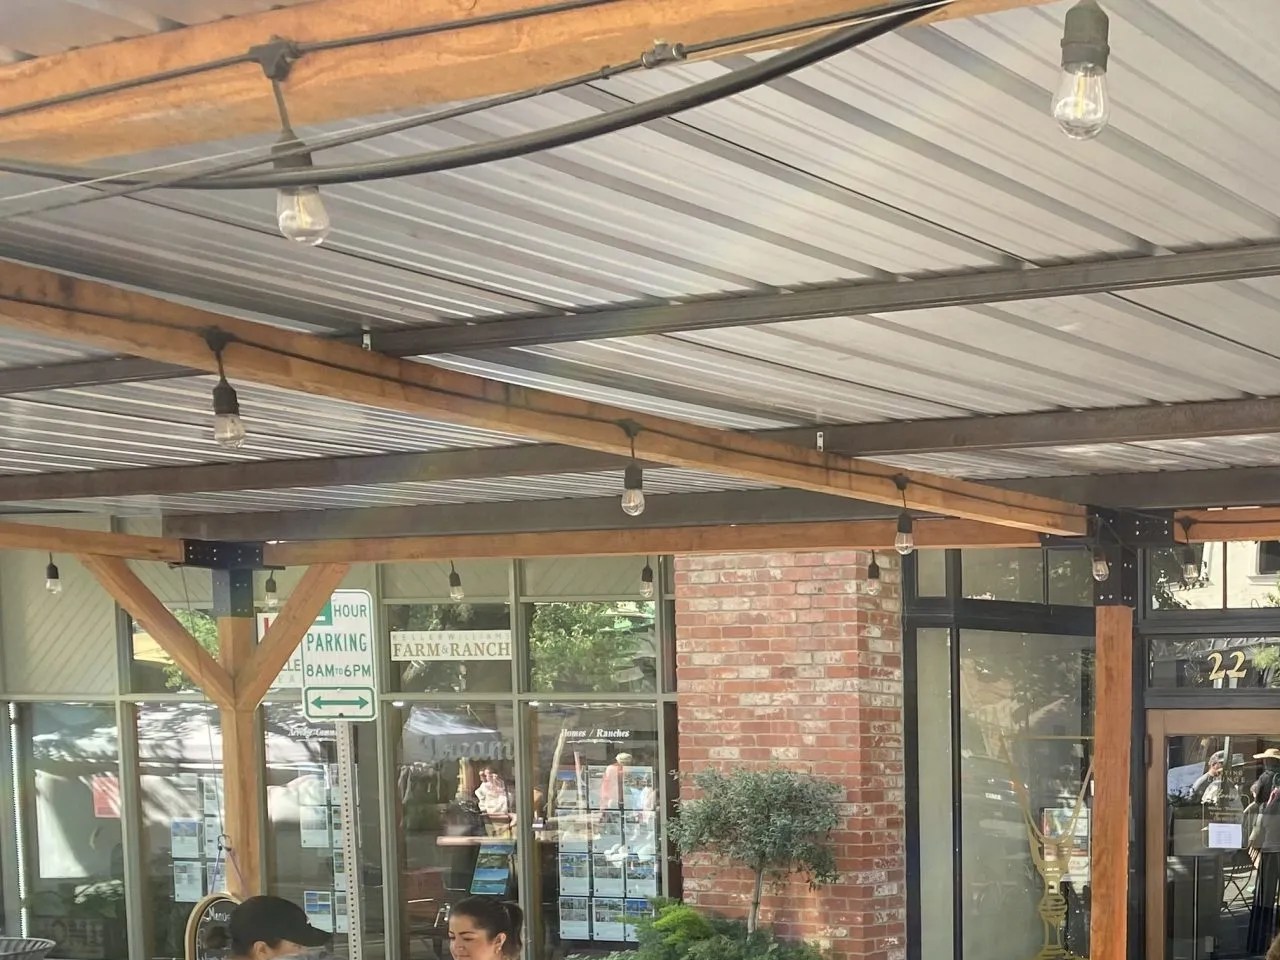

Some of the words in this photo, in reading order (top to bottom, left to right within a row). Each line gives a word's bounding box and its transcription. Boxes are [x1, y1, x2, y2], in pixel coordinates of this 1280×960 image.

[333, 604, 368, 618] HOUR
[306, 633, 368, 652] PARKING
[393, 643, 440, 657] FARM
[449, 642, 511, 656] RANCH
[306, 664, 335, 678] 8AM
[344, 664, 372, 678] 6PM
[1207, 650, 1247, 681] 22
